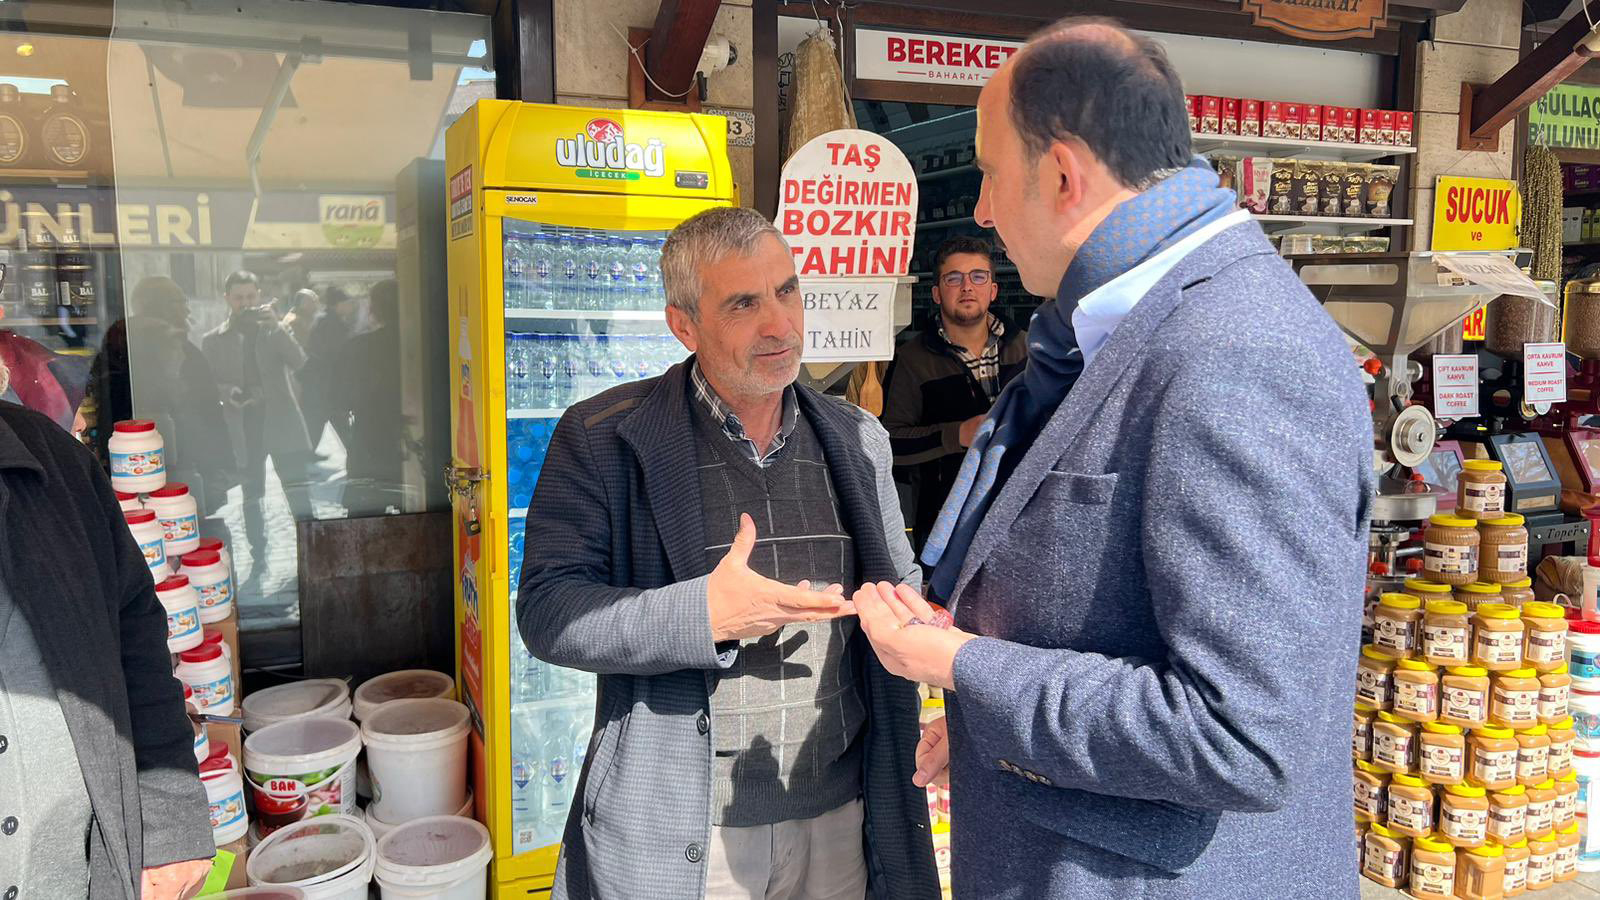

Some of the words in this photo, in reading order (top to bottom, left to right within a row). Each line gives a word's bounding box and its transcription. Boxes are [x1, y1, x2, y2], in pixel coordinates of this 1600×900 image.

[887, 37, 1018, 69] BEREKET
[928, 70, 980, 81] BAHARAT
[556, 133, 666, 177] uludağ
[826, 143, 881, 173] TAŞ
[784, 174, 912, 206] DEĞİRMEN
[1446, 186, 1511, 225] SUCUK
[783, 209, 912, 236] BOZKIR
[63, 234, 80, 243] BAL
[1471, 231, 1482, 241] ve
[31, 287, 49, 297] BAL
[79, 287, 95, 296] BAL
[804, 290, 879, 310] BEYAZ
[808, 328, 872, 348] TAHİN
[270, 781, 296, 792] BAN
